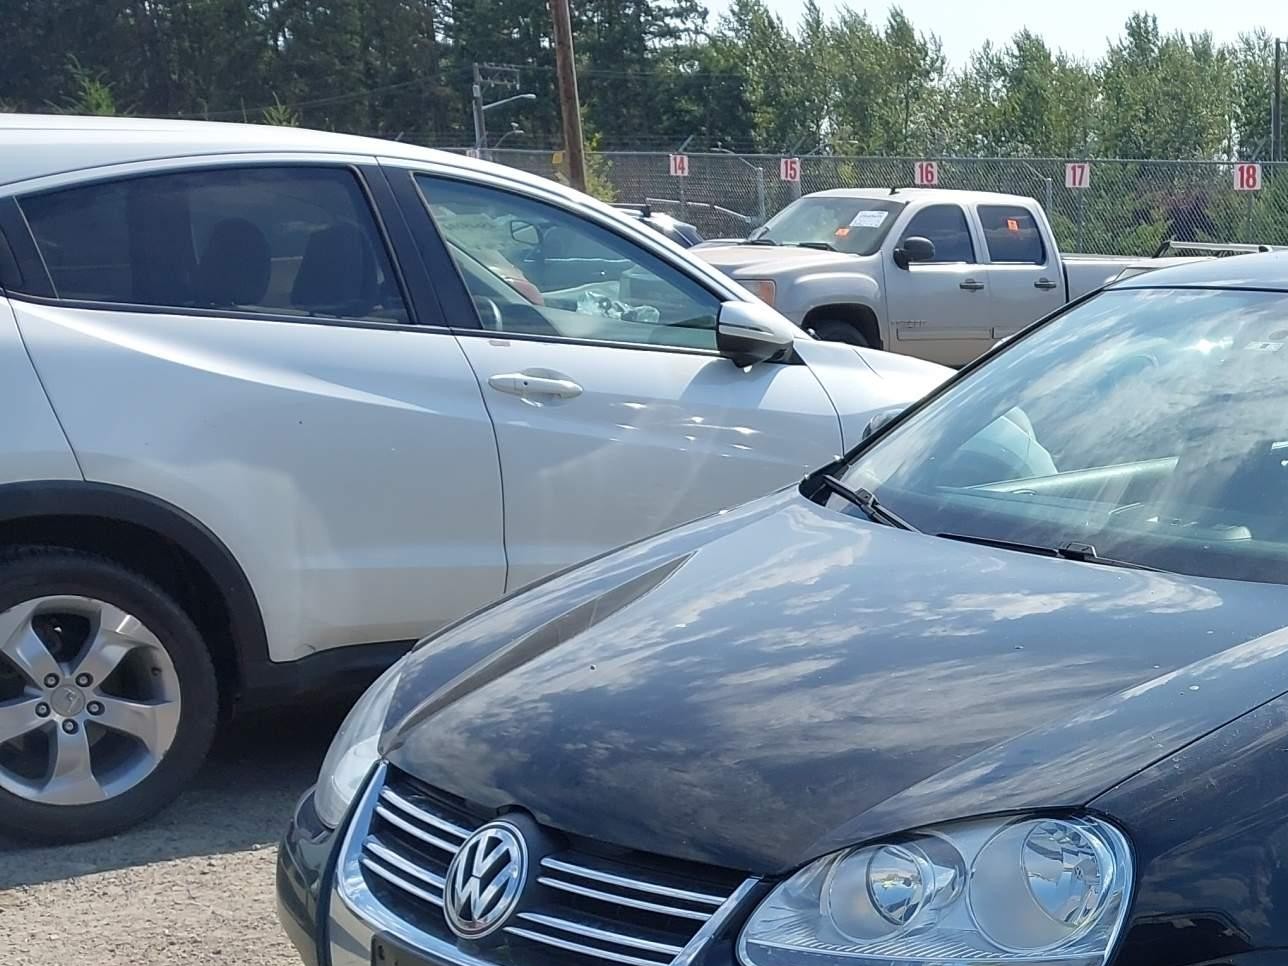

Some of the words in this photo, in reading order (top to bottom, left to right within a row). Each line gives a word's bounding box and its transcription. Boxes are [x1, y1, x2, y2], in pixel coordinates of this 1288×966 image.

[673, 156, 686, 175] 14
[784, 160, 797, 179] 15
[918, 163, 935, 185] 16
[1070, 165, 1086, 186] 17
[1237, 164, 1257, 189] 18
